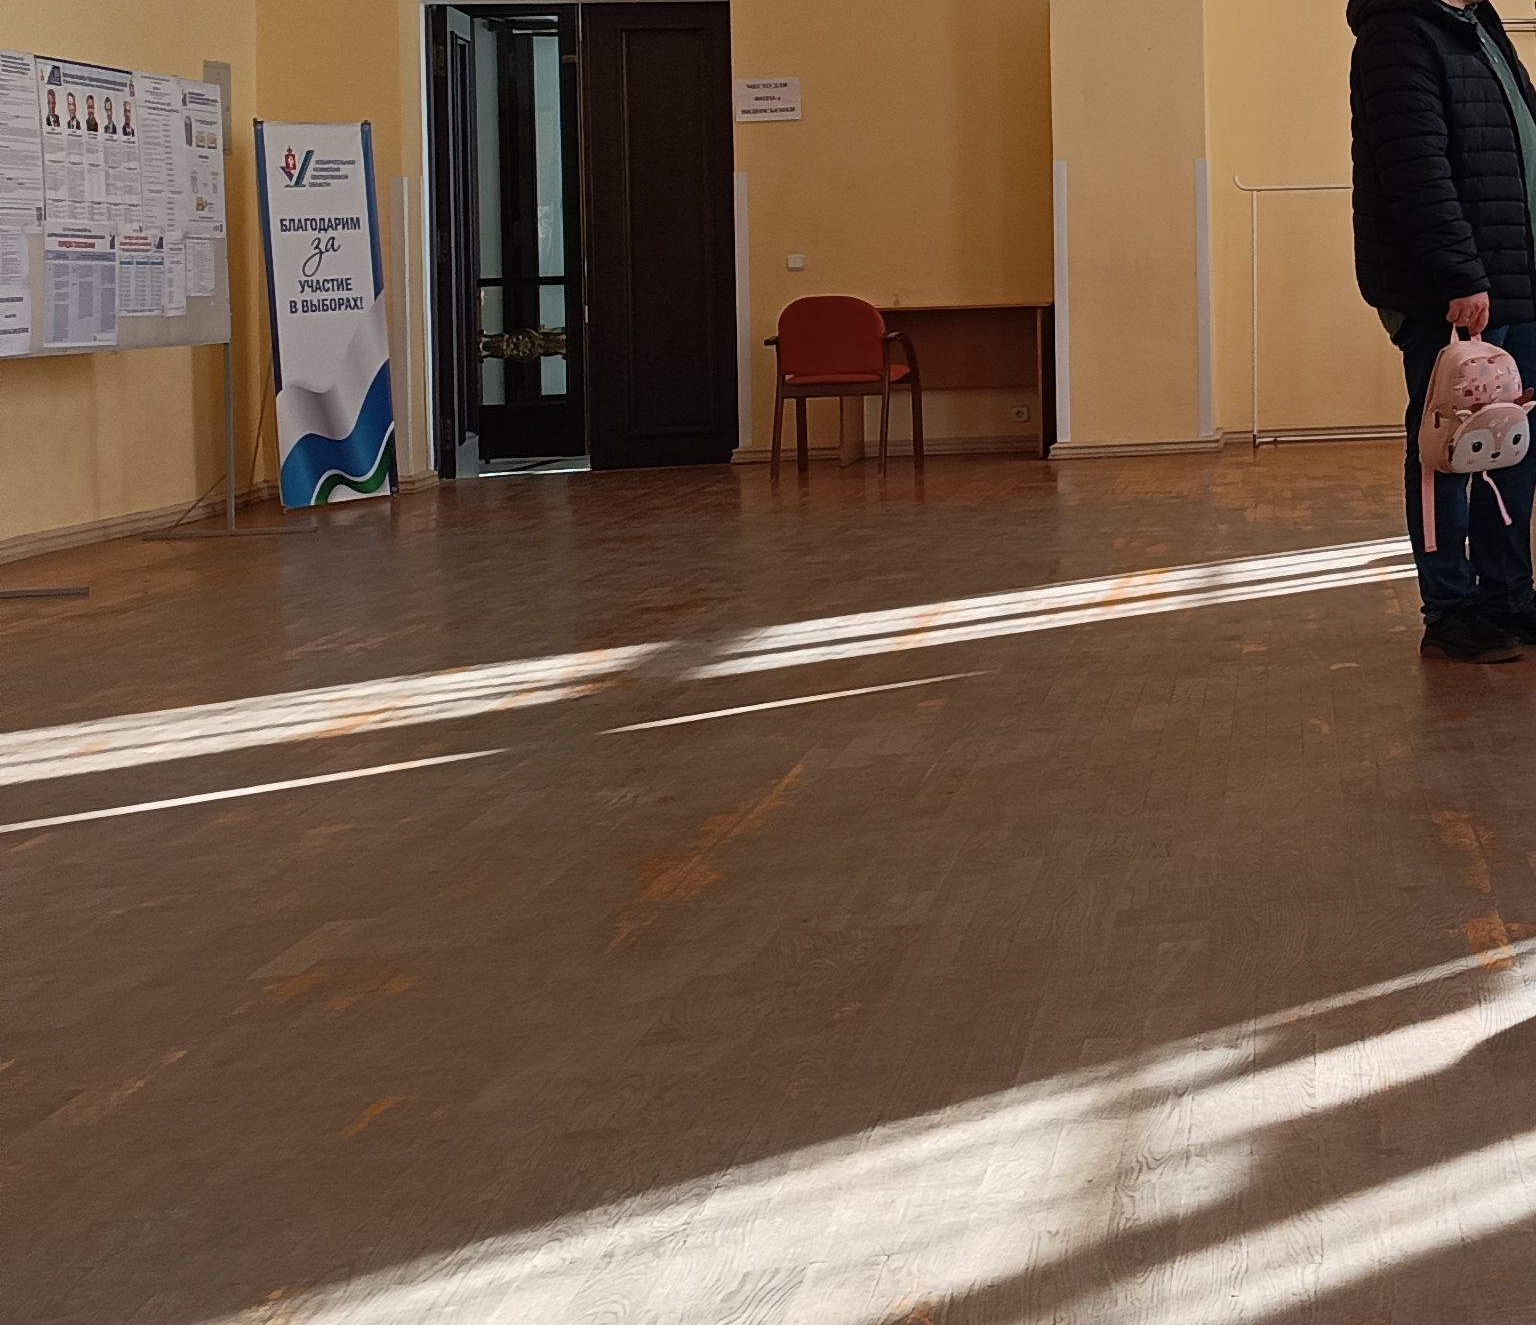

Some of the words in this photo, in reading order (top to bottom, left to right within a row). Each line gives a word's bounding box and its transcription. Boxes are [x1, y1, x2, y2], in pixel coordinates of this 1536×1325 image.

[279, 217, 361, 234] БЛАГОДАРИМ
[302, 236, 341, 278] за
[298, 277, 353, 294] УЧАСТИЕ
[289, 300, 298, 314] В
[301, 296, 364, 314] ВЫБОРАХ!
